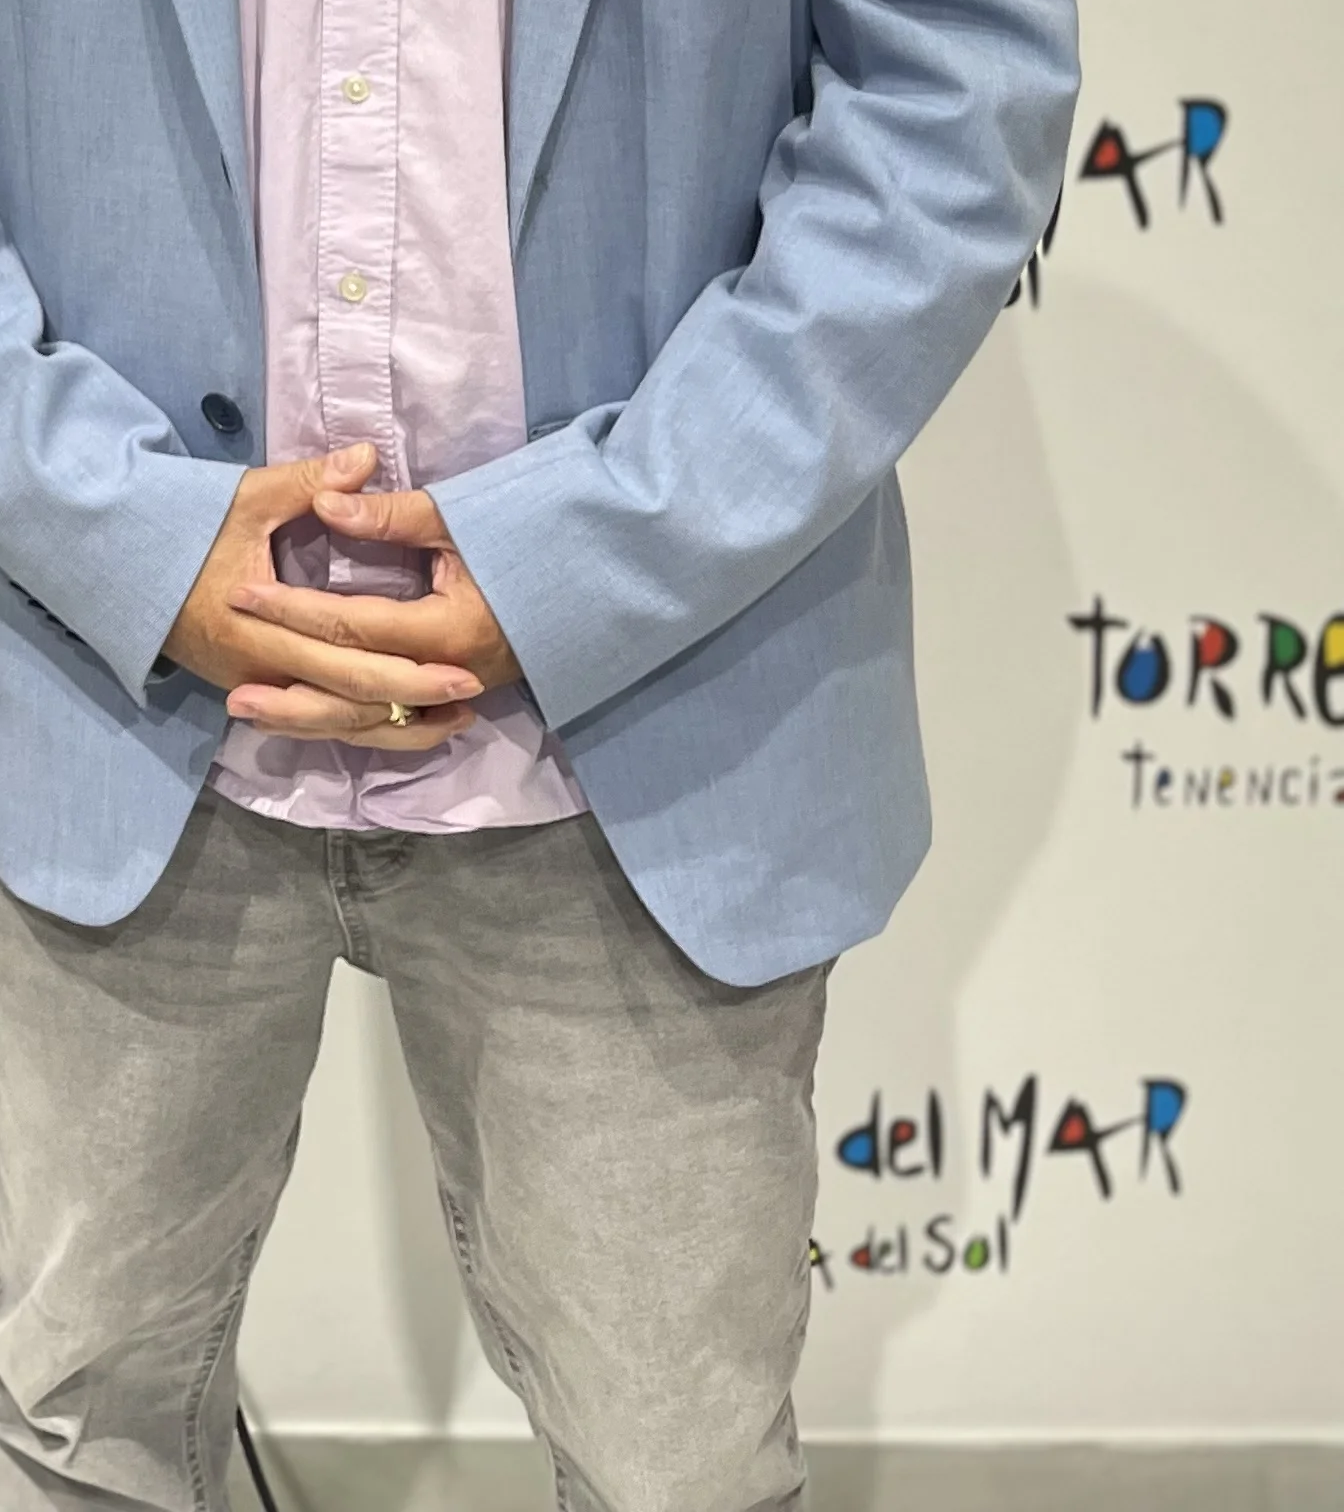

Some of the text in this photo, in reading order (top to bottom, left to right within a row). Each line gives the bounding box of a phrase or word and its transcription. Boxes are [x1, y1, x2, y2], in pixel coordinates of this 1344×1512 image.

[836, 1072, 1188, 1225] del MAR
[922, 1213, 1009, 1275] Sol
